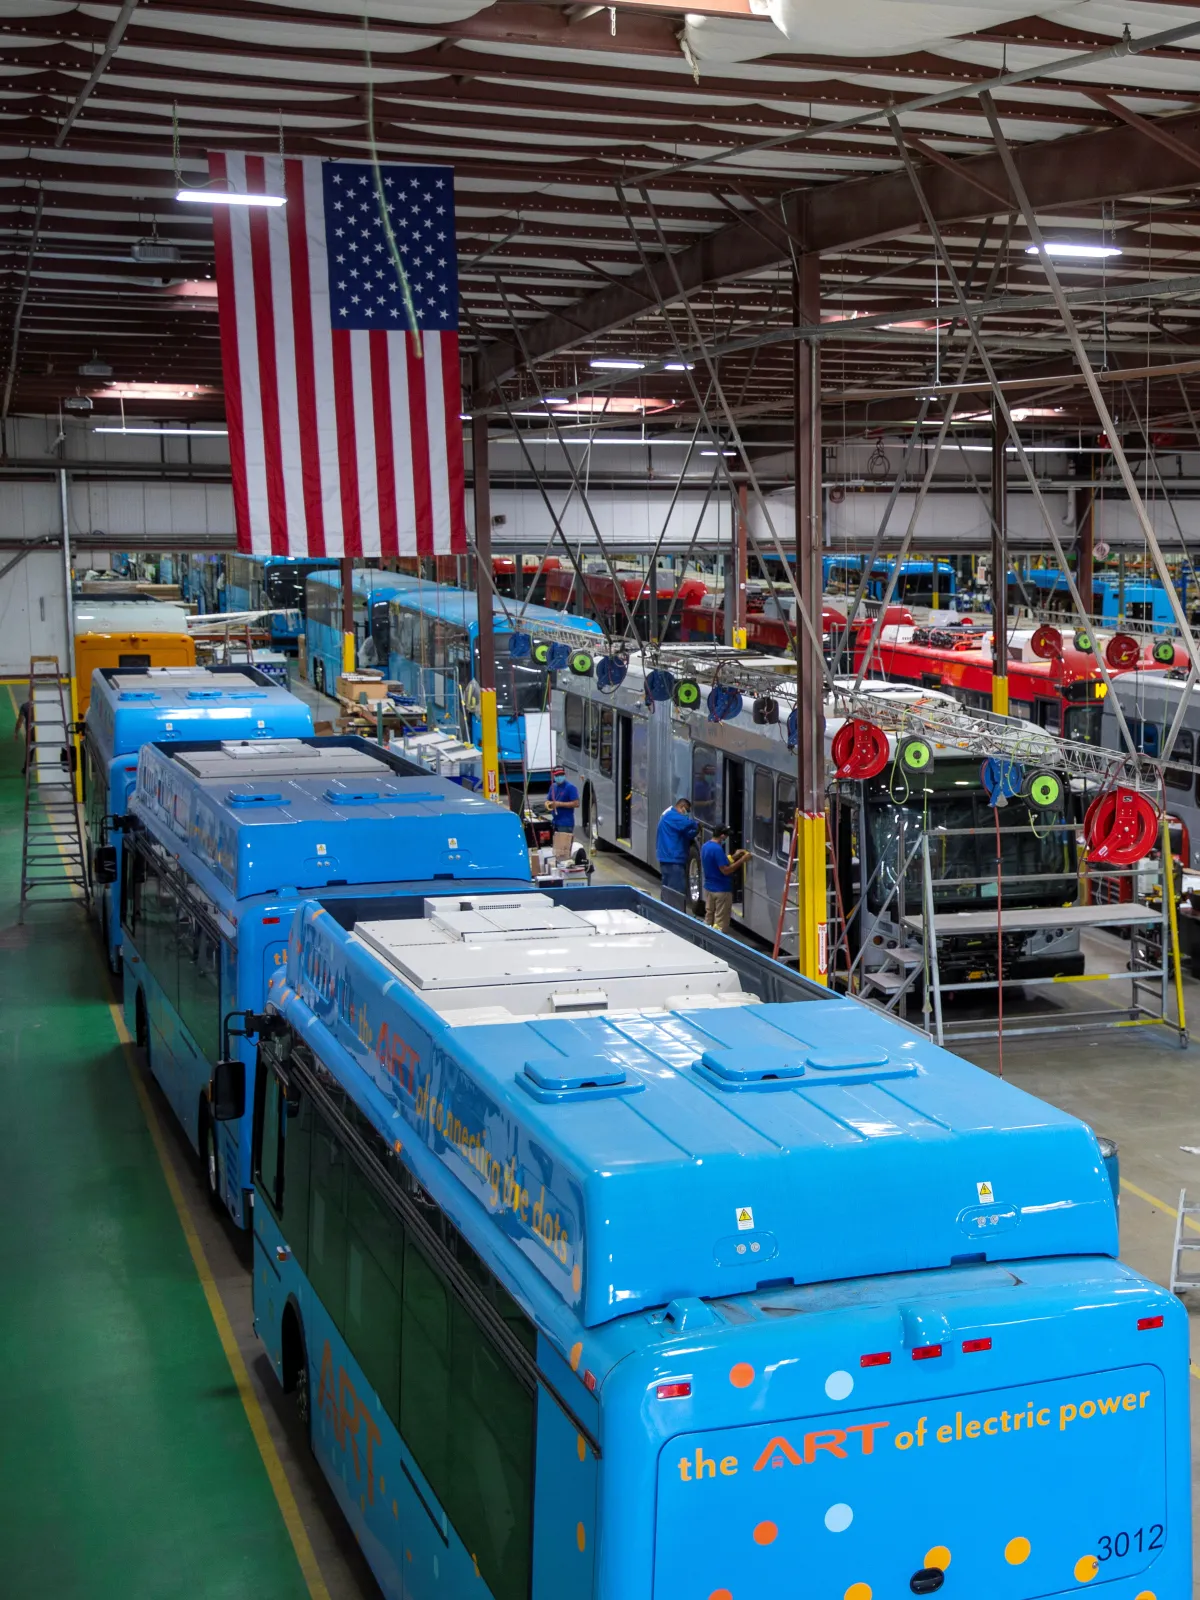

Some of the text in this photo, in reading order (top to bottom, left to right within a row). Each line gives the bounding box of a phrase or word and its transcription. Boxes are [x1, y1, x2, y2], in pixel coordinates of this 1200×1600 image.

[376, 1022, 421, 1094] ART
[429, 1096, 501, 1206] connecting
[503, 1156, 529, 1222] the
[532, 1184, 568, 1264] dots
[318, 1339, 382, 1506] ART
[678, 1389, 1151, 1482] the ART of electric power
[1097, 1523, 1165, 1562] 3012
